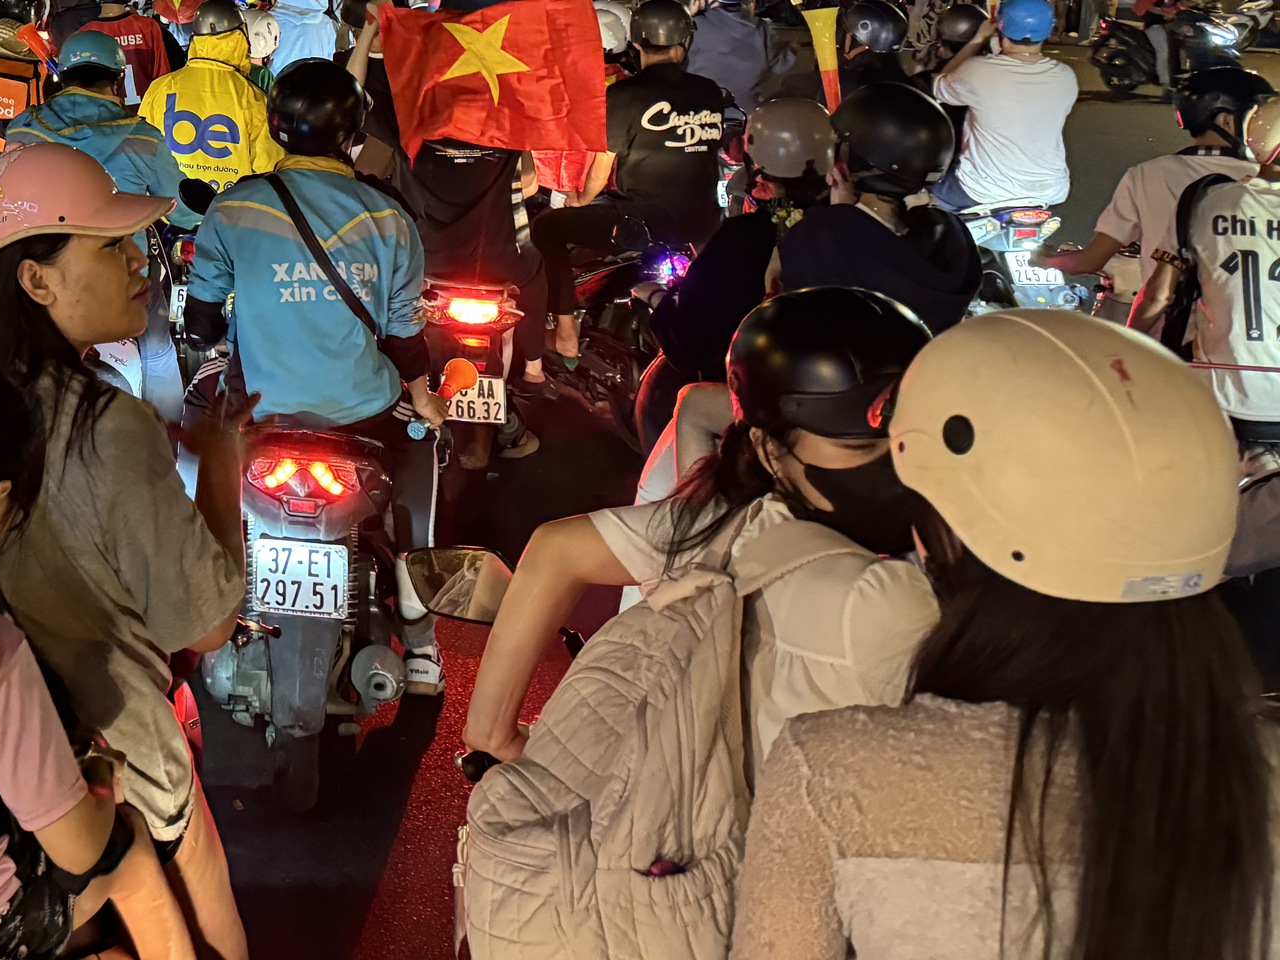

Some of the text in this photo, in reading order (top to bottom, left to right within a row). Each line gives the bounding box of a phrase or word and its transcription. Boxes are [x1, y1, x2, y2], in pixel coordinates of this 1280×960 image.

[164, 93, 240, 159] be
[641, 101, 723, 131] Christian
[279, 282, 317, 303] xin
[260, 577, 339, 612] 297.51
